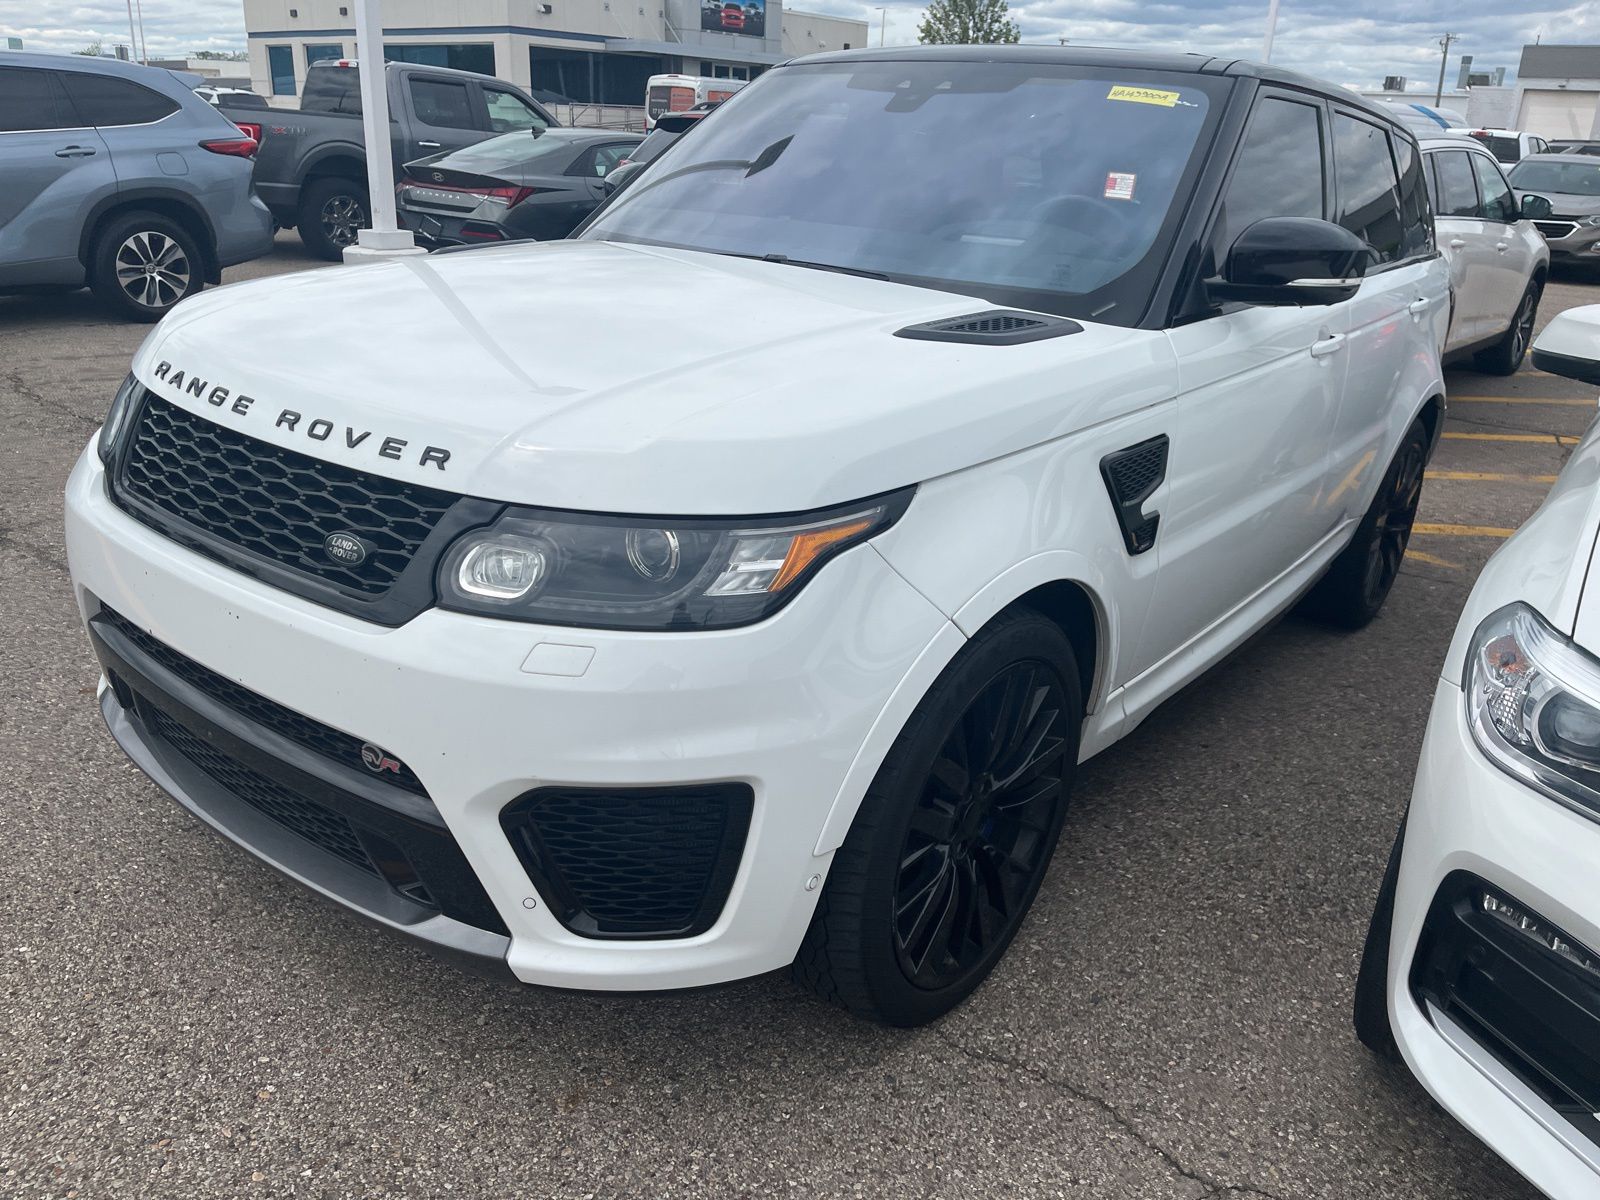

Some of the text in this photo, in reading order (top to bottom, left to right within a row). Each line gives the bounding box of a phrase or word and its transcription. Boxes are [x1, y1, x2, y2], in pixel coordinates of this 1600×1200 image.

[154, 360, 450, 470] RANGE ROVER
[331, 537, 353, 550] LAND
[332, 547, 358, 560] ROVER
